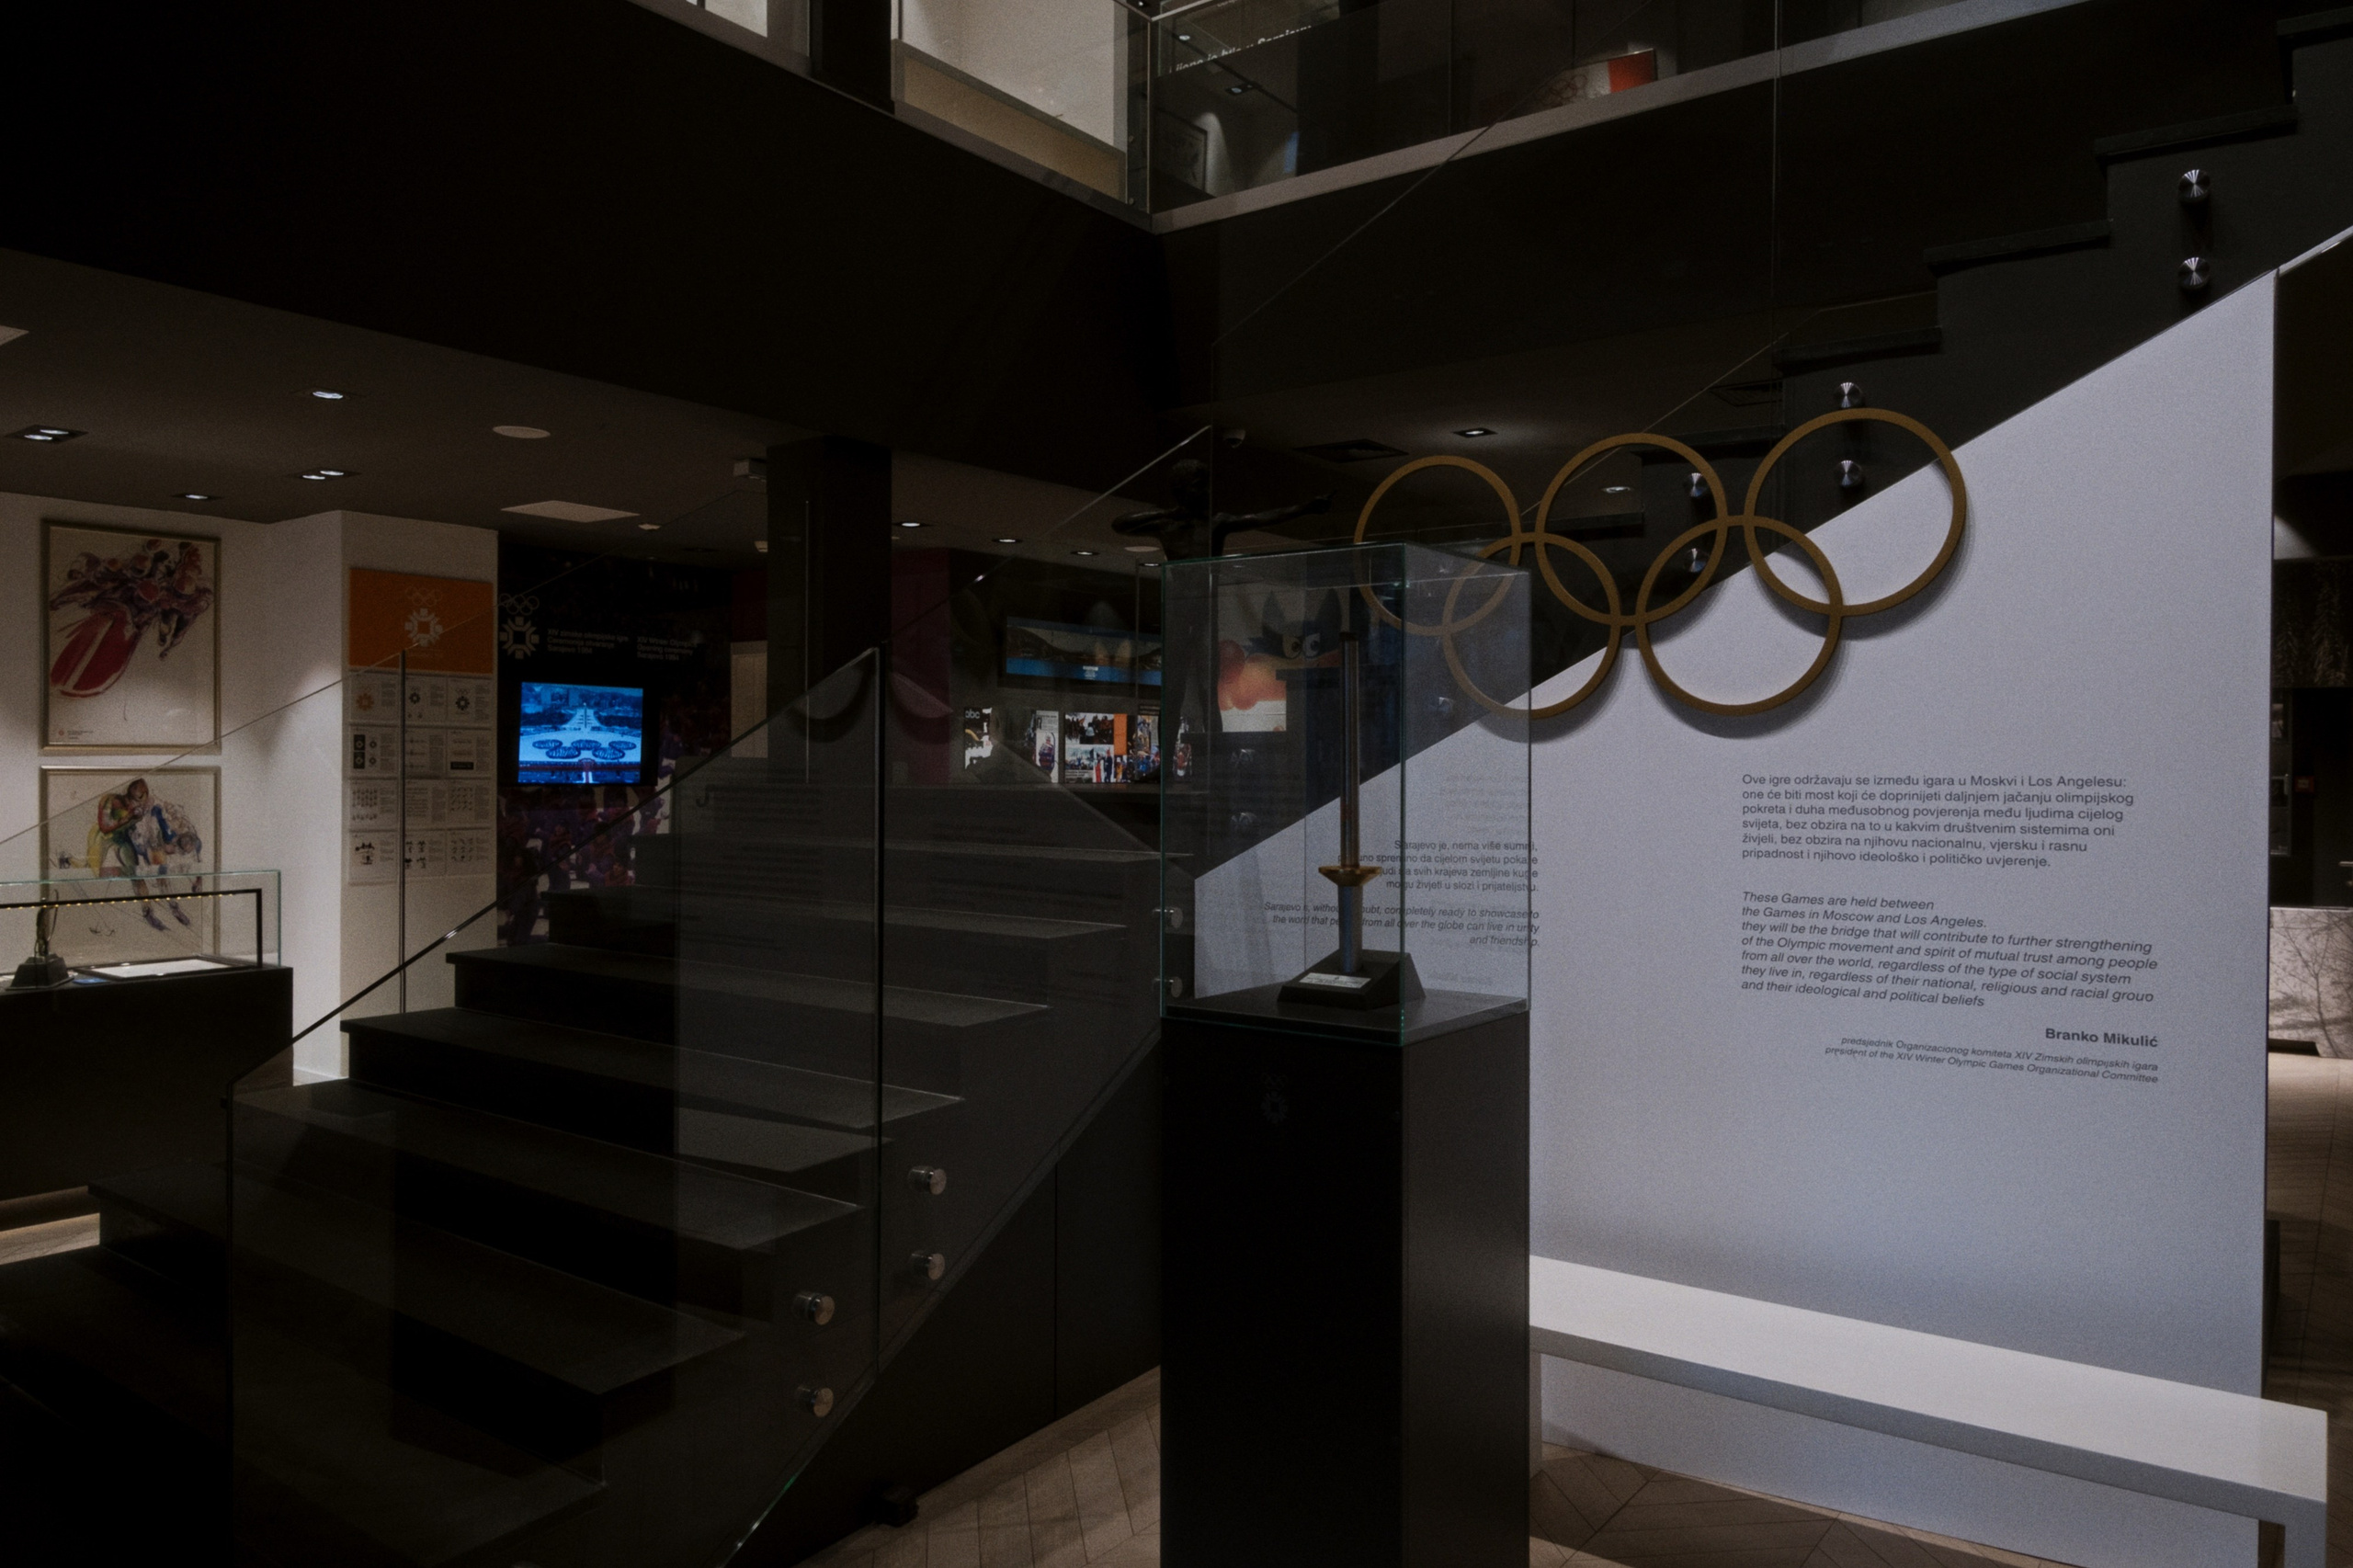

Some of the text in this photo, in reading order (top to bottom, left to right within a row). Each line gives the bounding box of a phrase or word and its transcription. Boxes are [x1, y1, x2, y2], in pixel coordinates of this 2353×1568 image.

[965, 710, 981, 719] abc
[1742, 774, 2127, 790] Ove igre održavaju između igara Moskvi Los Angelesu:
[1742, 790, 2134, 807] one biti most koji doprinijeti daljnjem jačanju olimpijskog
[1742, 804, 2124, 823] pokreta duha međusobnog povjerenja među ljudima cijelog
[1742, 819, 2116, 836] svijeta, bez obzira kakvim društvenim sistemima oni
[1452, 842, 1479, 850] nema
[1482, 841, 1501, 850] više
[1742, 833, 2088, 852] živjeli, bez obzira njihovu nacionalnu, vjersku rasnu
[1435, 855, 1468, 865] cijelom
[1471, 855, 1501, 866] svijetu
[1504, 855, 1538, 866] pokae
[1741, 848, 2052, 869] pripadnost njihovo ideološko političko uvjerenje.
[1414, 867, 1510, 879] svih krajeva zemljine
[1453, 881, 1474, 891] slozi
[1744, 891, 1935, 910] These Games are held between
[1264, 902, 1302, 912] Sarajevo
[1438, 908, 1465, 918] ready
[1479, 909, 1528, 919] showcase
[1741, 906, 1760, 916] the
[1763, 907, 1805, 918] Games
[1823, 910, 1873, 922] Moscow
[1877, 915, 1901, 924] and
[1904, 915, 1927, 925] Los
[1272, 915, 1286, 924] the
[1312, 915, 1328, 926] that
[1384, 918, 1395, 927] all
[1421, 920, 1436, 928] the
[1438, 920, 1464, 931] globe
[1467, 922, 1484, 930] can
[1487, 922, 1503, 931] live
[1470, 936, 1540, 948] and friendshp.
[1741, 921, 2153, 955] they will the bridge that will contribute further strengthening
[1756, 937, 2159, 971] the Olympic movement and spirit mutual trust among people
[1741, 949, 2131, 984] from all over the world, regardless the type social system
[1741, 965, 1766, 978] they
[1768, 967, 1789, 977] live
[1791, 968, 1805, 979] in,
[1809, 971, 1872, 983] regardless
[1892, 975, 1917, 985] their
[1922, 978, 1977, 992] national,
[1981, 982, 2038, 995] religious
[2040, 986, 2068, 996] and
[2070, 988, 2109, 999] racial
[1741, 981, 1985, 1006] and their ideological and political beliefs
[2044, 1028, 2159, 1048] Branko Mikulić
